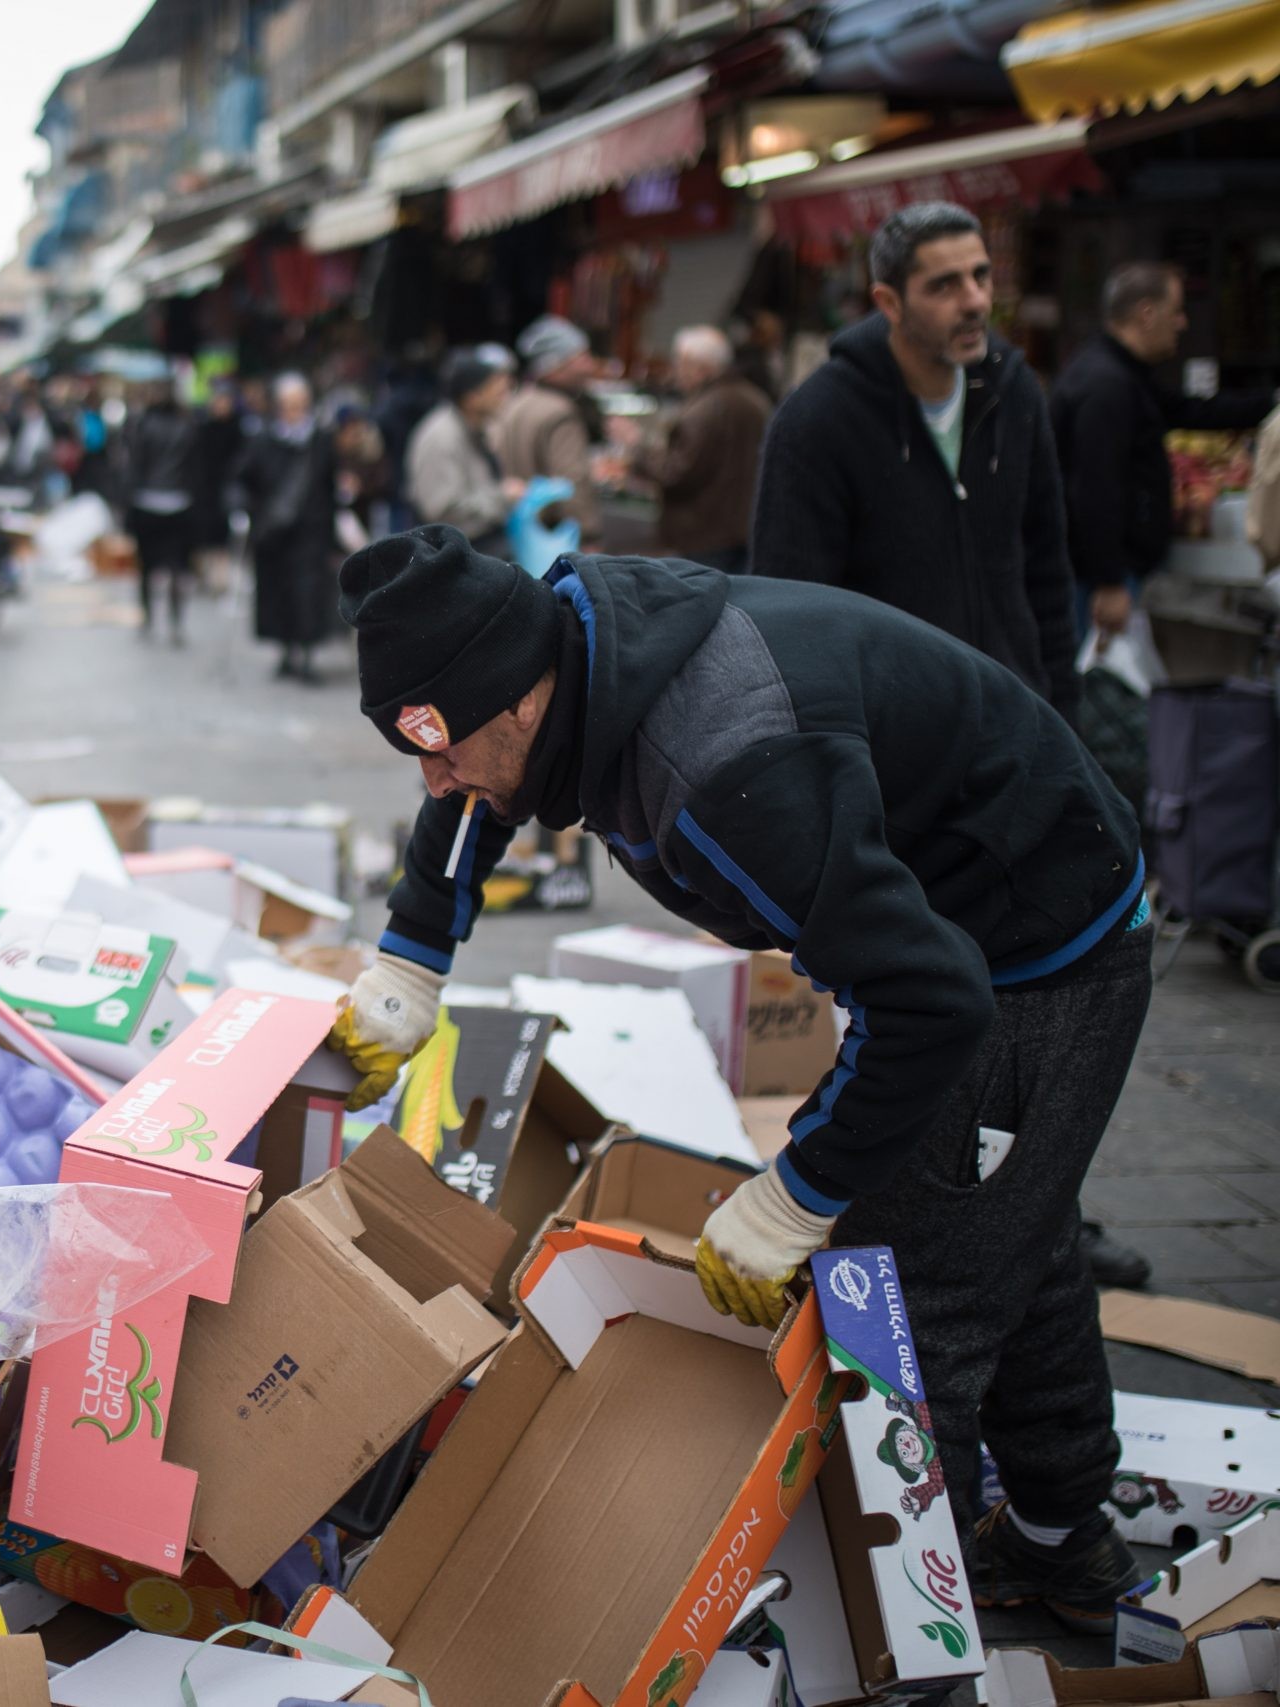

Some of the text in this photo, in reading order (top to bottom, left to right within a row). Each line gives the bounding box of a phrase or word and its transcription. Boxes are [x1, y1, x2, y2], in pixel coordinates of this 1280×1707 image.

[875, 1252, 890, 1280] גיל
[882, 1281, 907, 1341] הדחליל
[103, 1363, 129, 1420] פינק
[246, 1372, 278, 1403] קרגל
[23, 1386, 50, 1518] www.pri-beresheet.co.il
[163, 1542, 178, 1560] 18
[682, 1506, 761, 1643] אפרסמון
[717, 1565, 752, 1616] מור
